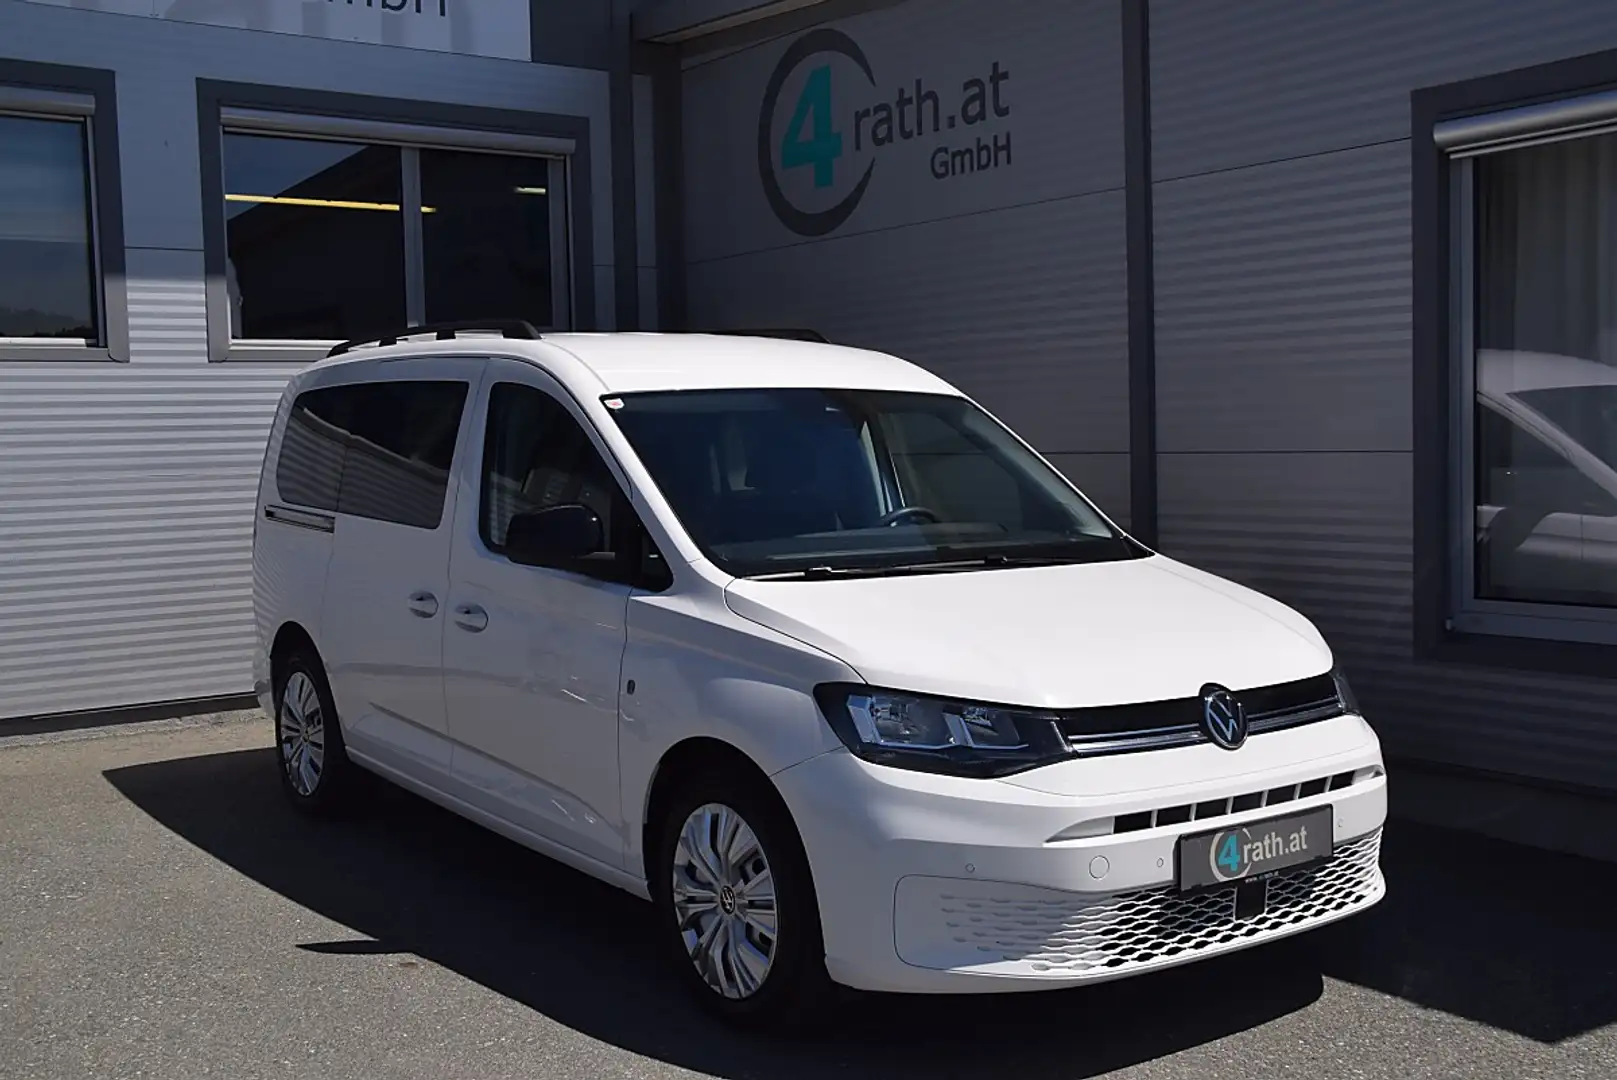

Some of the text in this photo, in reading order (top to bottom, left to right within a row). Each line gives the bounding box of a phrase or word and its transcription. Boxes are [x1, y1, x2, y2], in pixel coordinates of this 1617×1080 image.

[781, 61, 1010, 189] 4rath.at
[929, 131, 1012, 180] GmbH
[1217, 826, 1308, 872] 4rath.at
